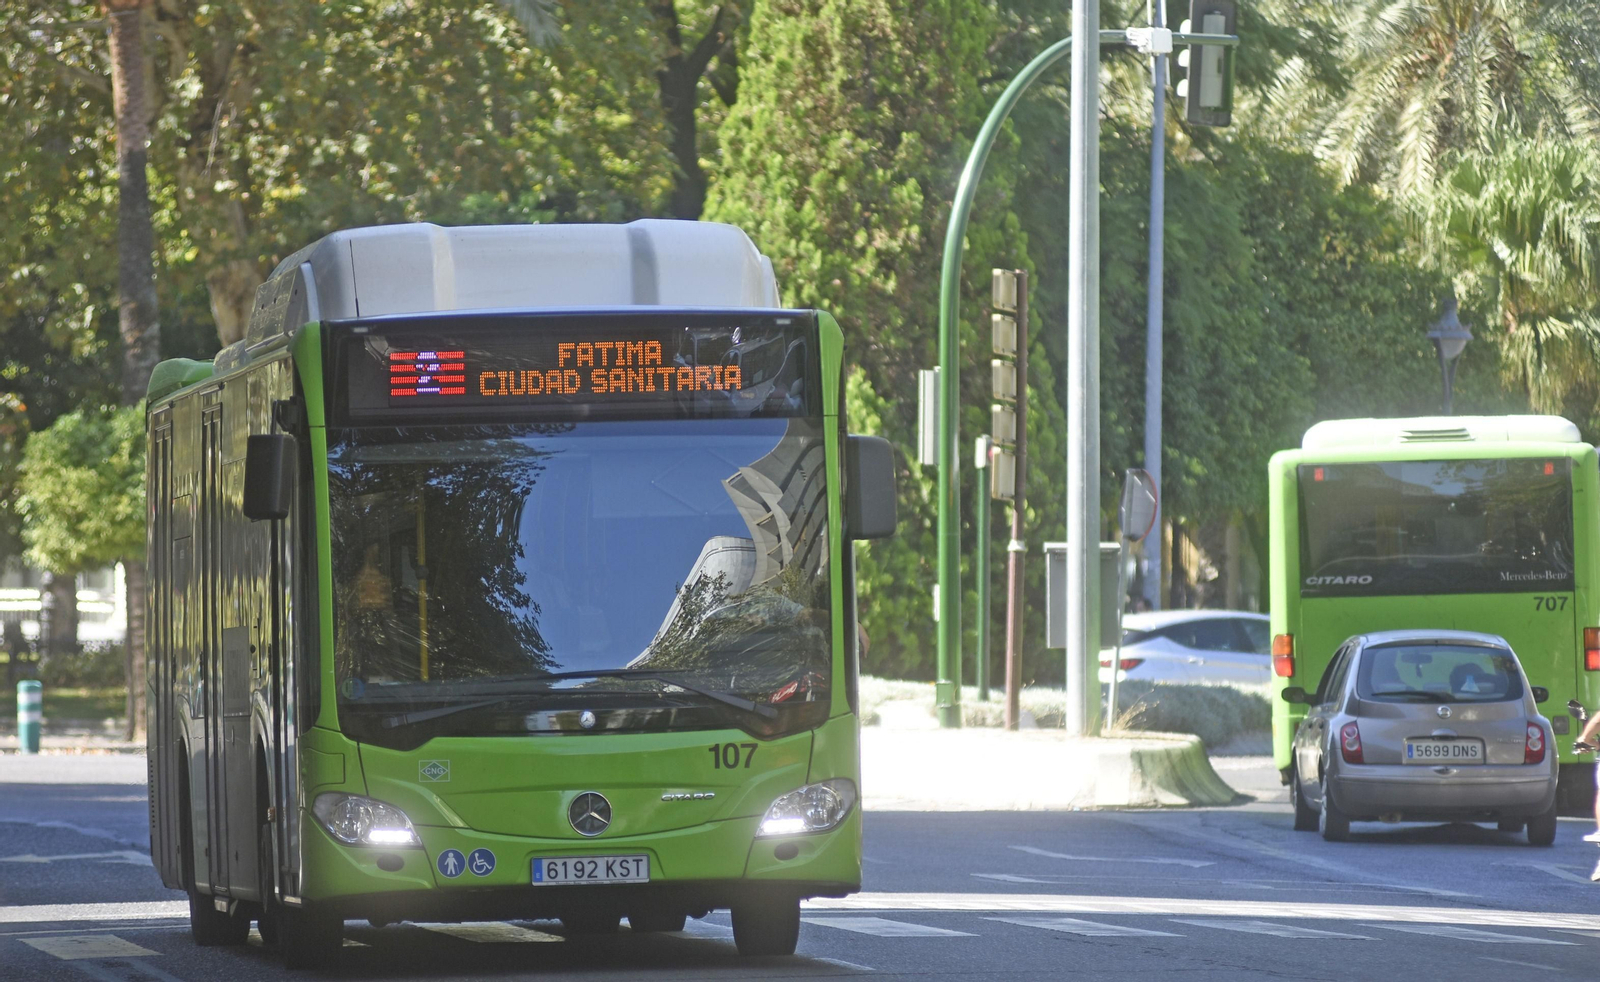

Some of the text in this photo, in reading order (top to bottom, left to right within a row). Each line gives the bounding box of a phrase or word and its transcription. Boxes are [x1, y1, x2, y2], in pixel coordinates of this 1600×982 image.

[558, 340, 662, 368] FATIMA
[479, 365, 742, 396] CIUDAD SANITARIA
[1305, 575, 1373, 585] CITARO
[1500, 570, 1567, 581] Mercedes-Benz
[1533, 596, 1568, 611] 707
[708, 742, 759, 769] 107
[1416, 745, 1449, 757] 5699
[1452, 745, 1478, 757] DNS
[424, 767, 444, 775] CNG
[661, 792, 715, 802] CITARO
[547, 858, 644, 880] 6192 KST
